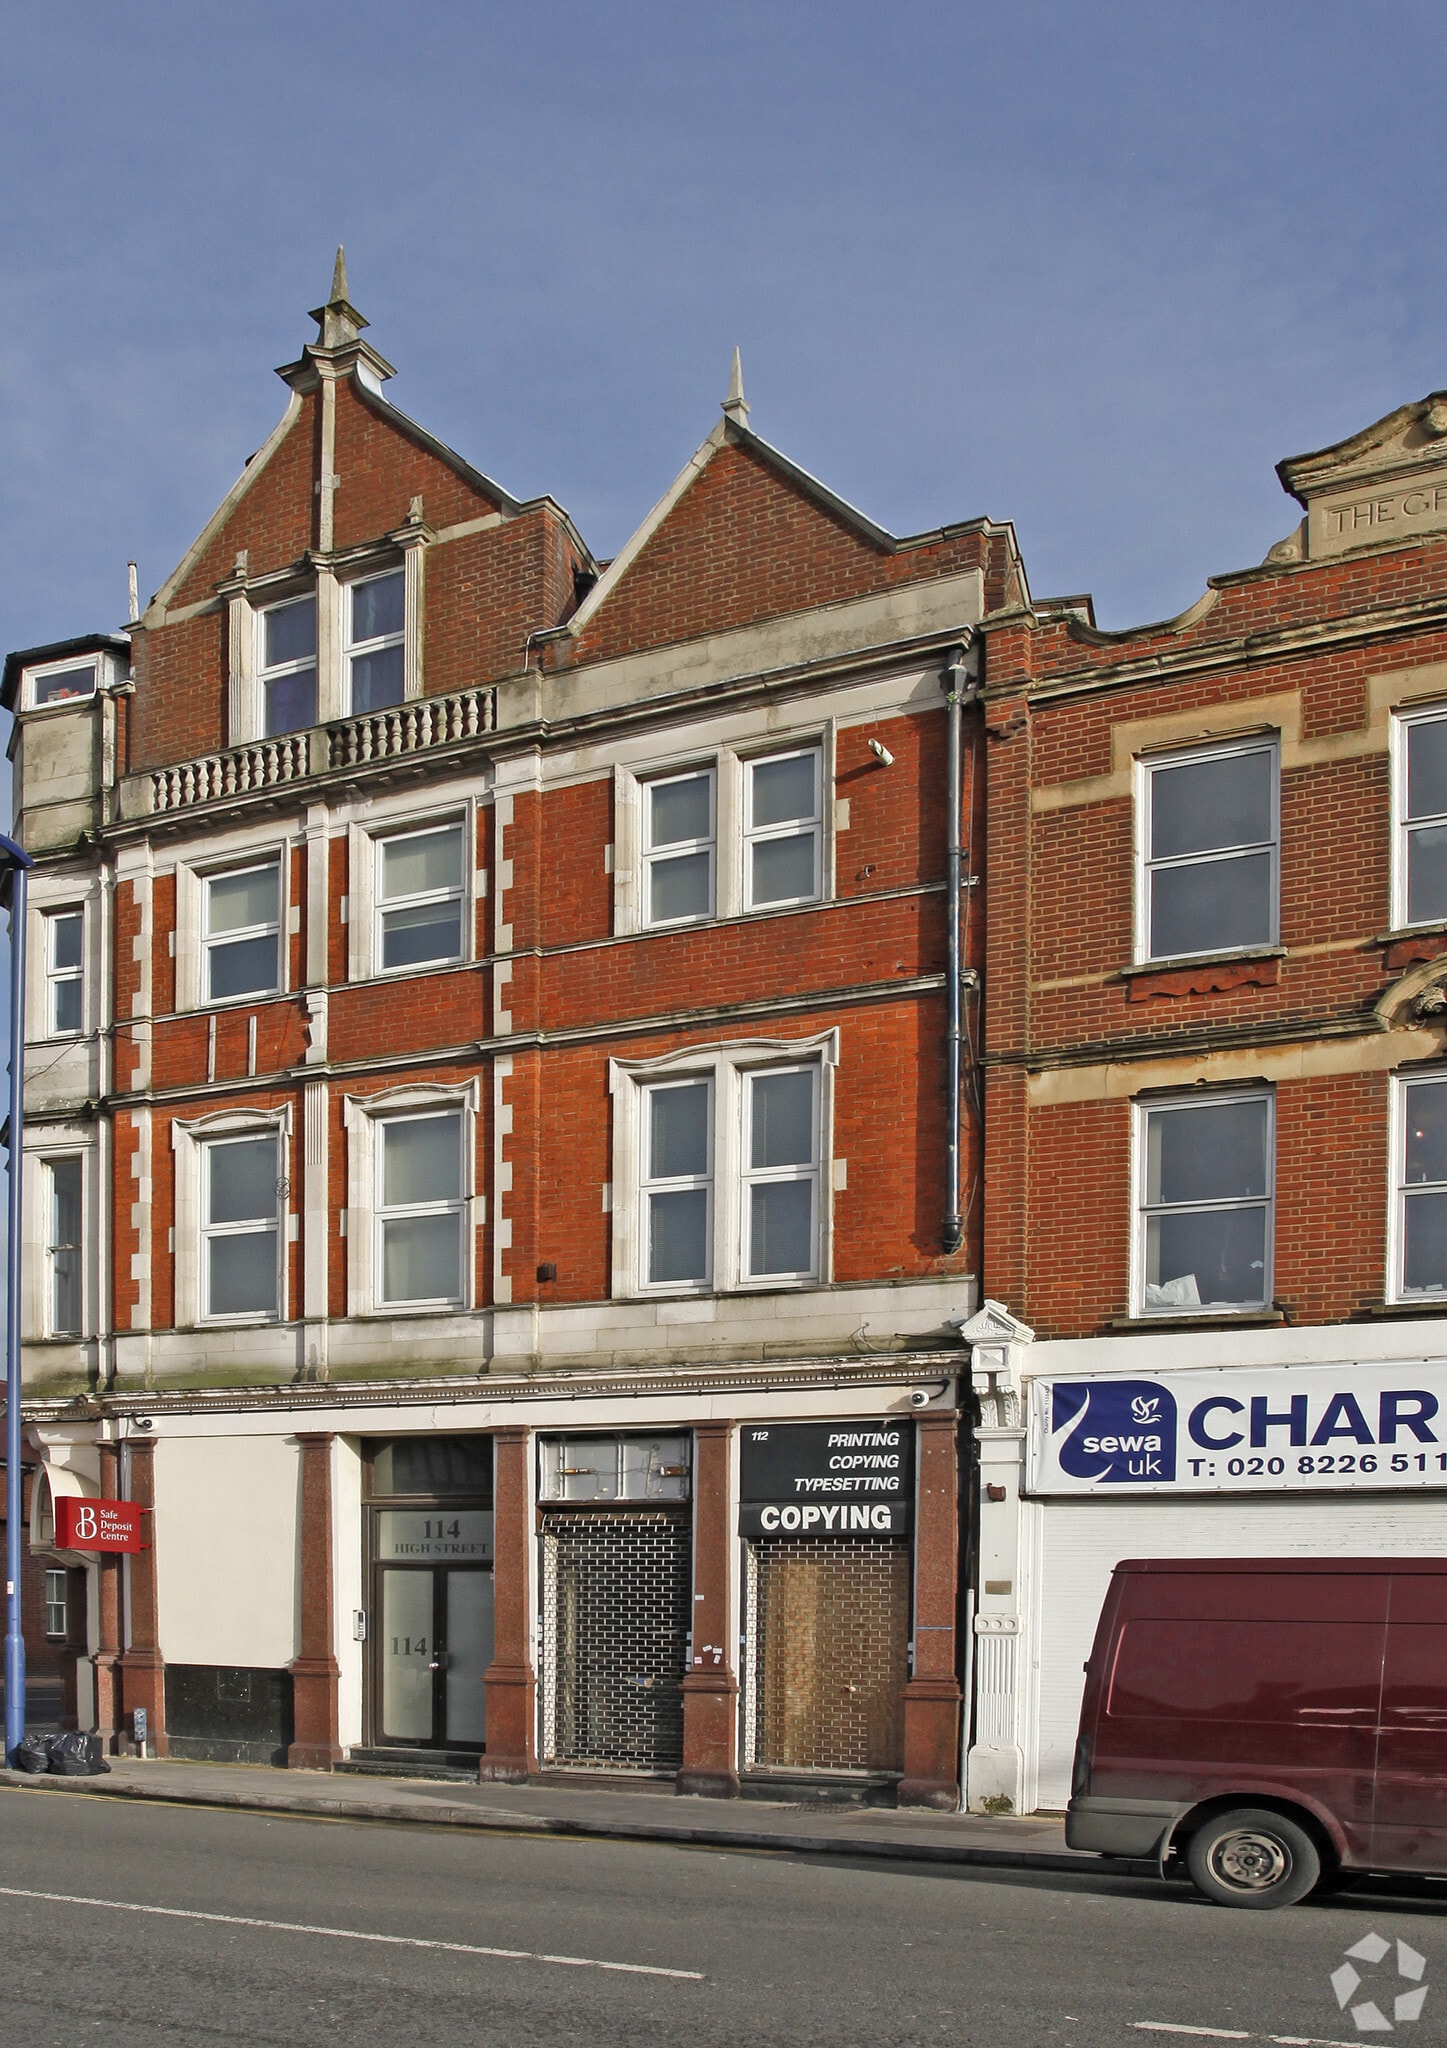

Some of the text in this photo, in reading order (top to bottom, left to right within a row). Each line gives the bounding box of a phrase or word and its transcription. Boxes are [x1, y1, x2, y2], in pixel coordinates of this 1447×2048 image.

[1330, 498, 1395, 533] THE
[1188, 1389, 1439, 1451] CHAR
[751, 1431, 769, 1441] 112
[827, 1432, 900, 1447] PRINTING
[1082, 1434, 1162, 1454] sewa
[829, 1454, 900, 1469] COPYING
[1128, 1453, 1162, 1476] uk
[1187, 1453, 1447, 1477] T: 020 8226 511
[794, 1476, 900, 1491] TYPESETTING
[75, 1506, 98, 1539] B
[100, 1509, 118, 1519] Safe
[760, 1504, 892, 1530] COPYING
[100, 1520, 133, 1532] Deposit
[100, 1531, 129, 1541] Centre
[424, 1519, 461, 1539] 114
[394, 1543, 488, 1554] HIGH STREET
[391, 1636, 427, 1656] 114
